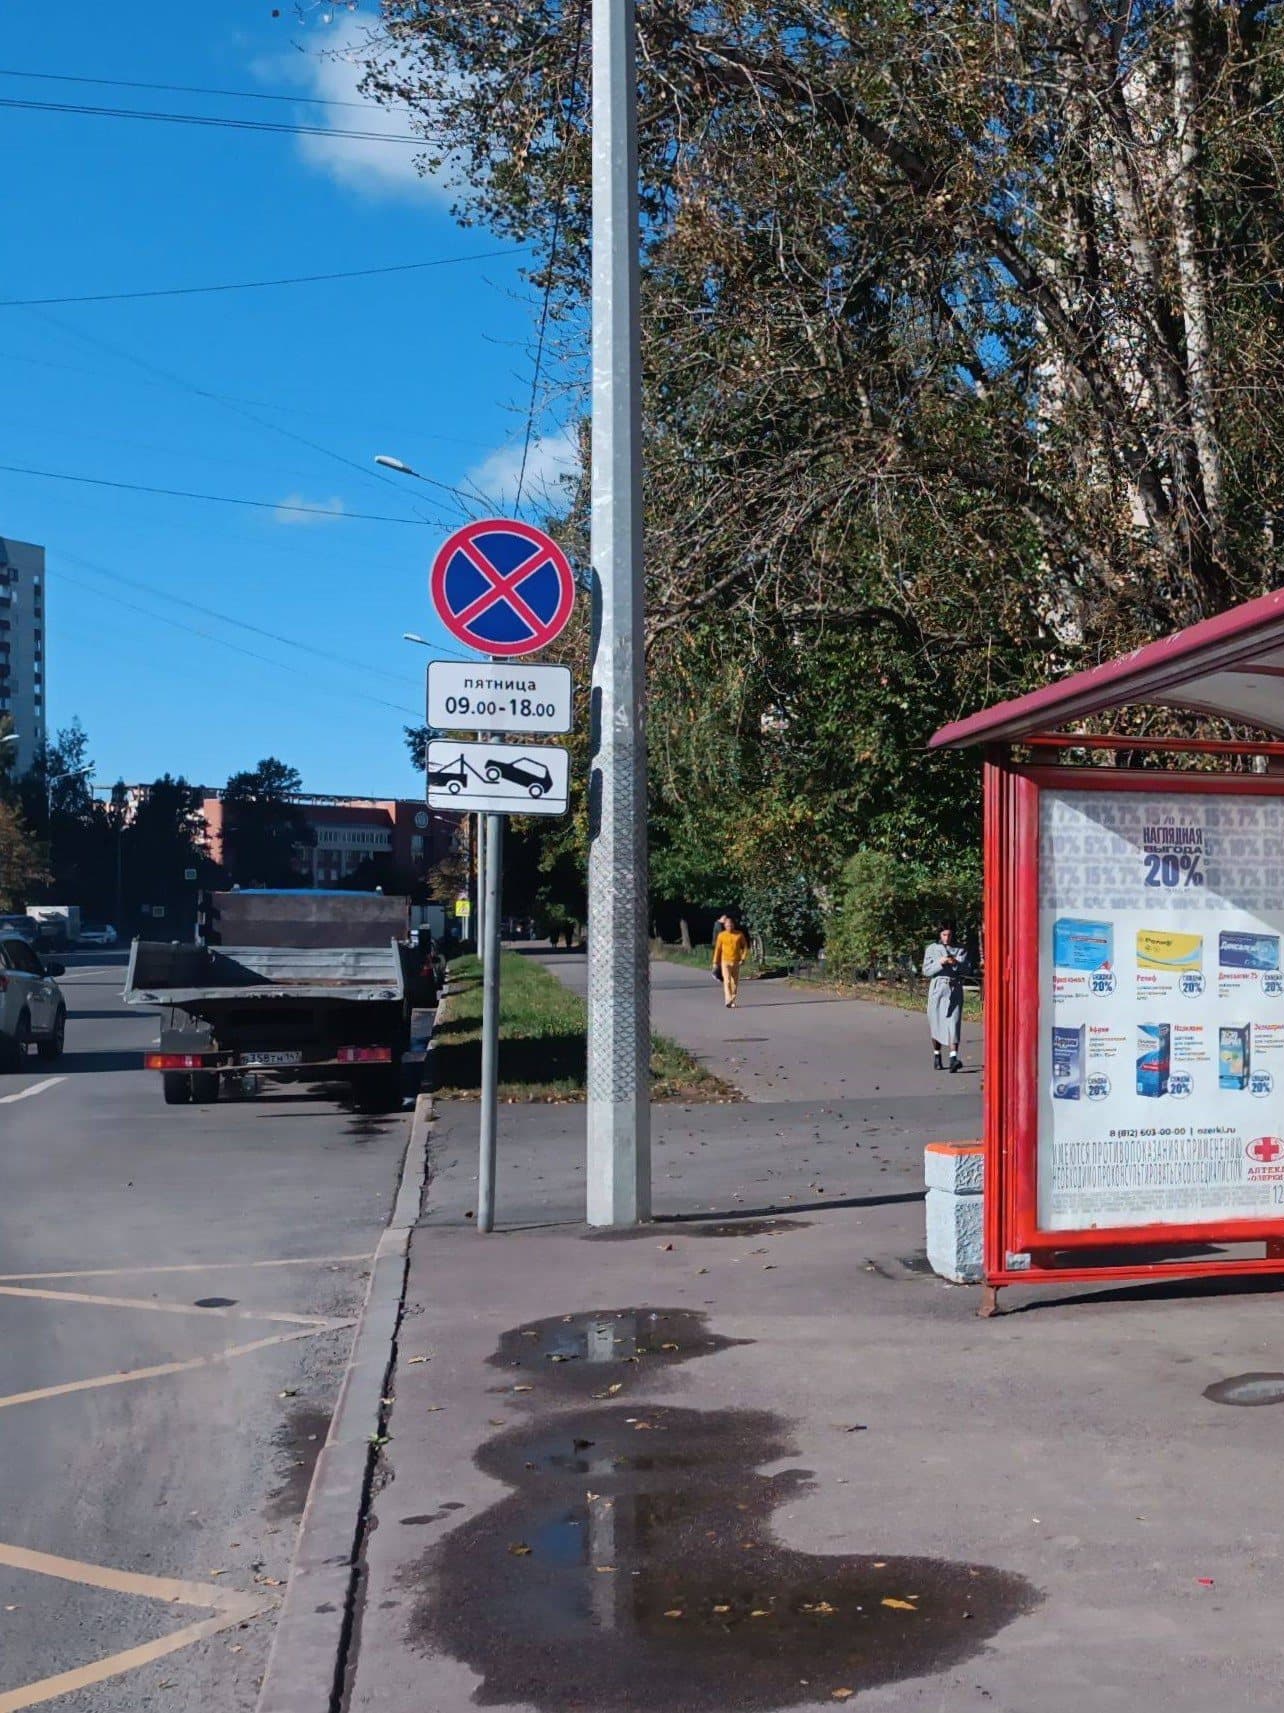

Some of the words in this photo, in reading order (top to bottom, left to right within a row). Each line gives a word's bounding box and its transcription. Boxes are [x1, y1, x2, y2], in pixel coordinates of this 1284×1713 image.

[464, 678, 537, 692] пятница
[445, 696, 555, 717] 09.00-18.00
[1143, 827, 1202, 845] НАГЛЯДНАЯ
[1144, 845, 1202, 854] ВЫГОДА
[1144, 854, 1204, 887] 20%
[1092, 981, 1113, 992] 20%
[1183, 982, 1202, 992] 20%
[1264, 982, 1283, 992] 20%
[1088, 1085, 1107, 1096] 20%
[1170, 1083, 1190, 1094] 20%
[1252, 1082, 1270, 1093] 20%
